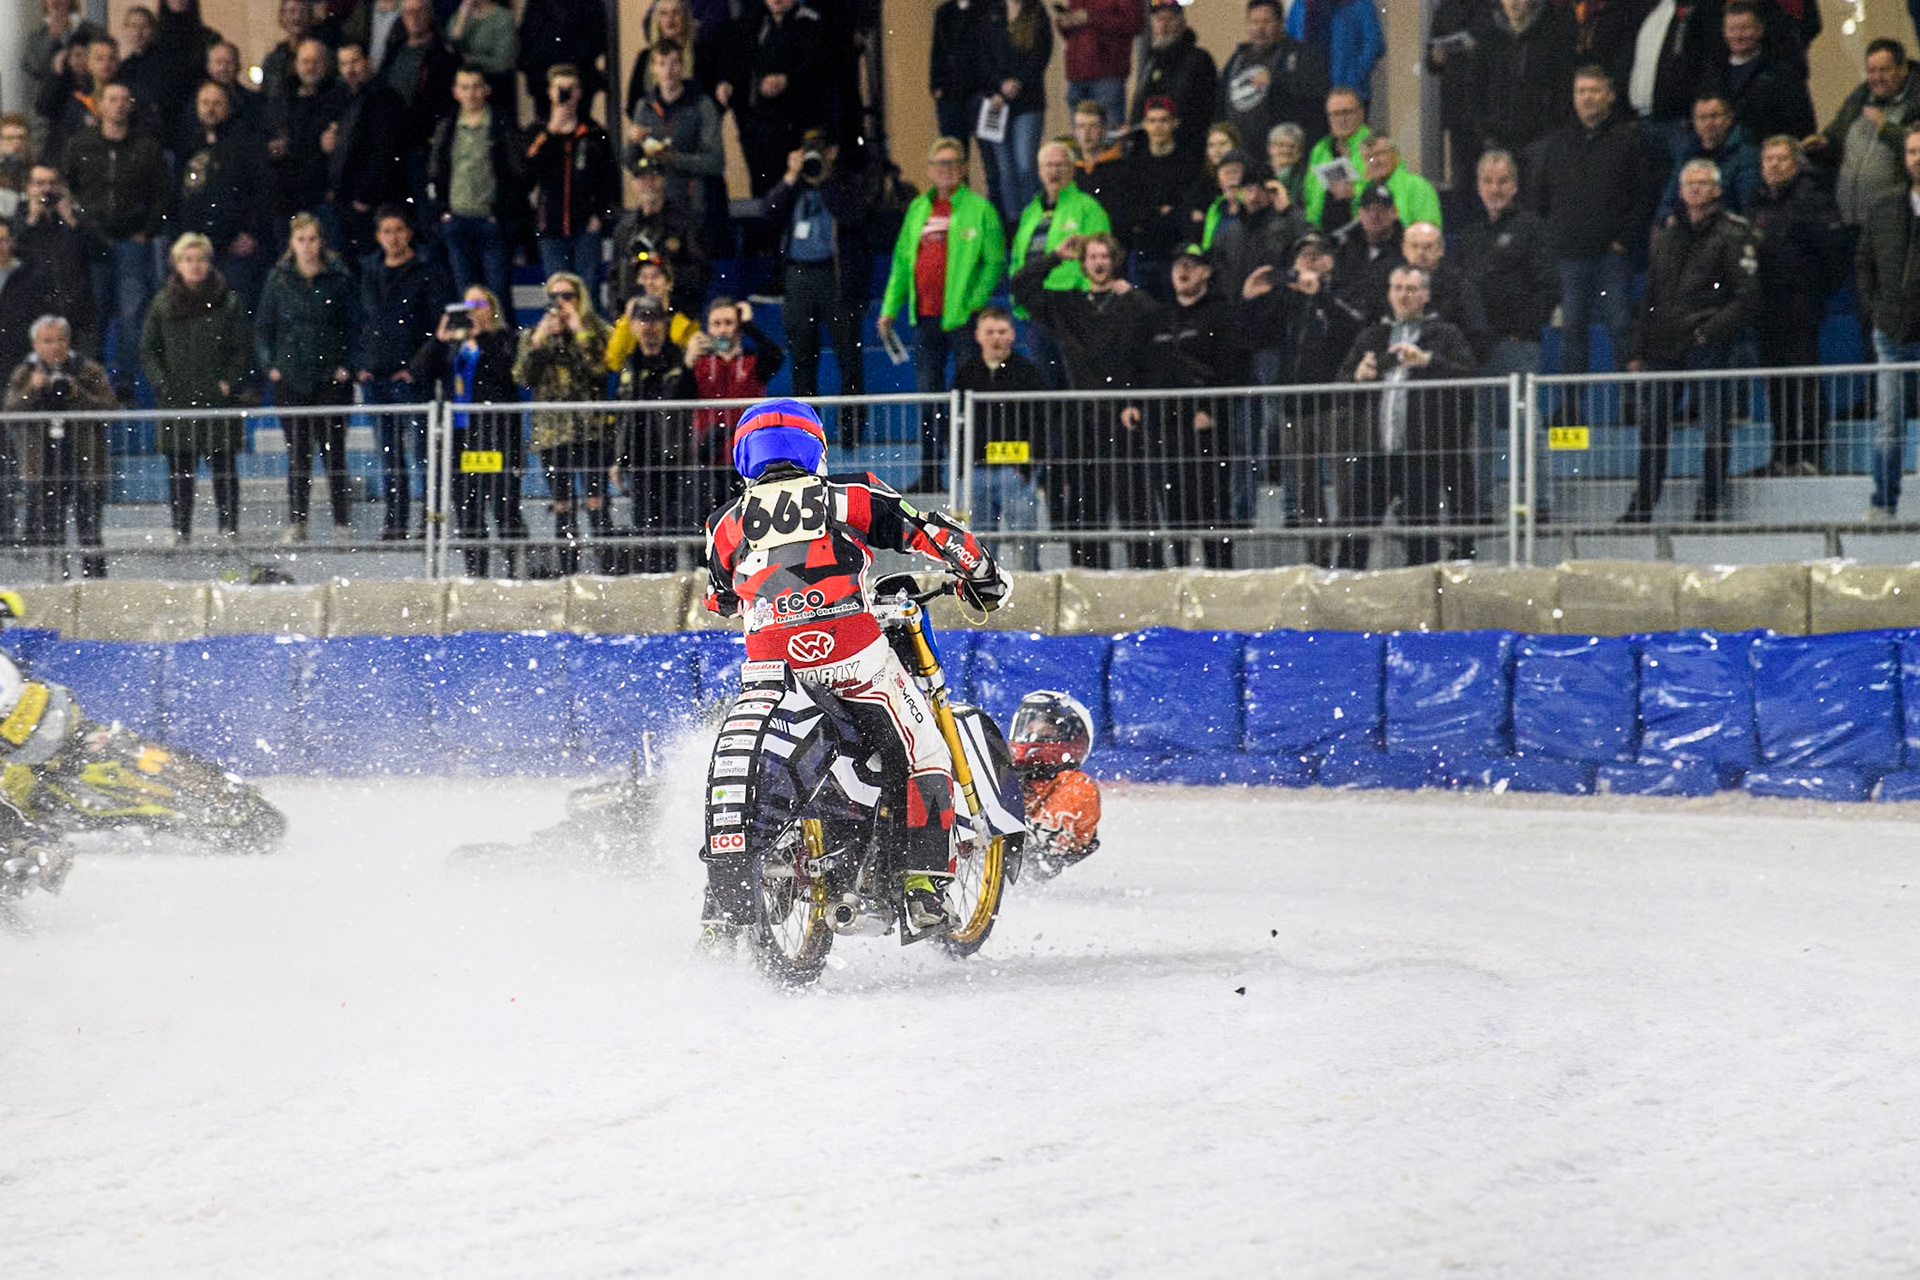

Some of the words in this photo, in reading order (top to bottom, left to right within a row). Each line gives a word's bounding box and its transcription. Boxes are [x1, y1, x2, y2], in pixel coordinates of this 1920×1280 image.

[743, 484, 824, 540] 665
[776, 590, 824, 614] ECO
[712, 834, 744, 848] ECO
